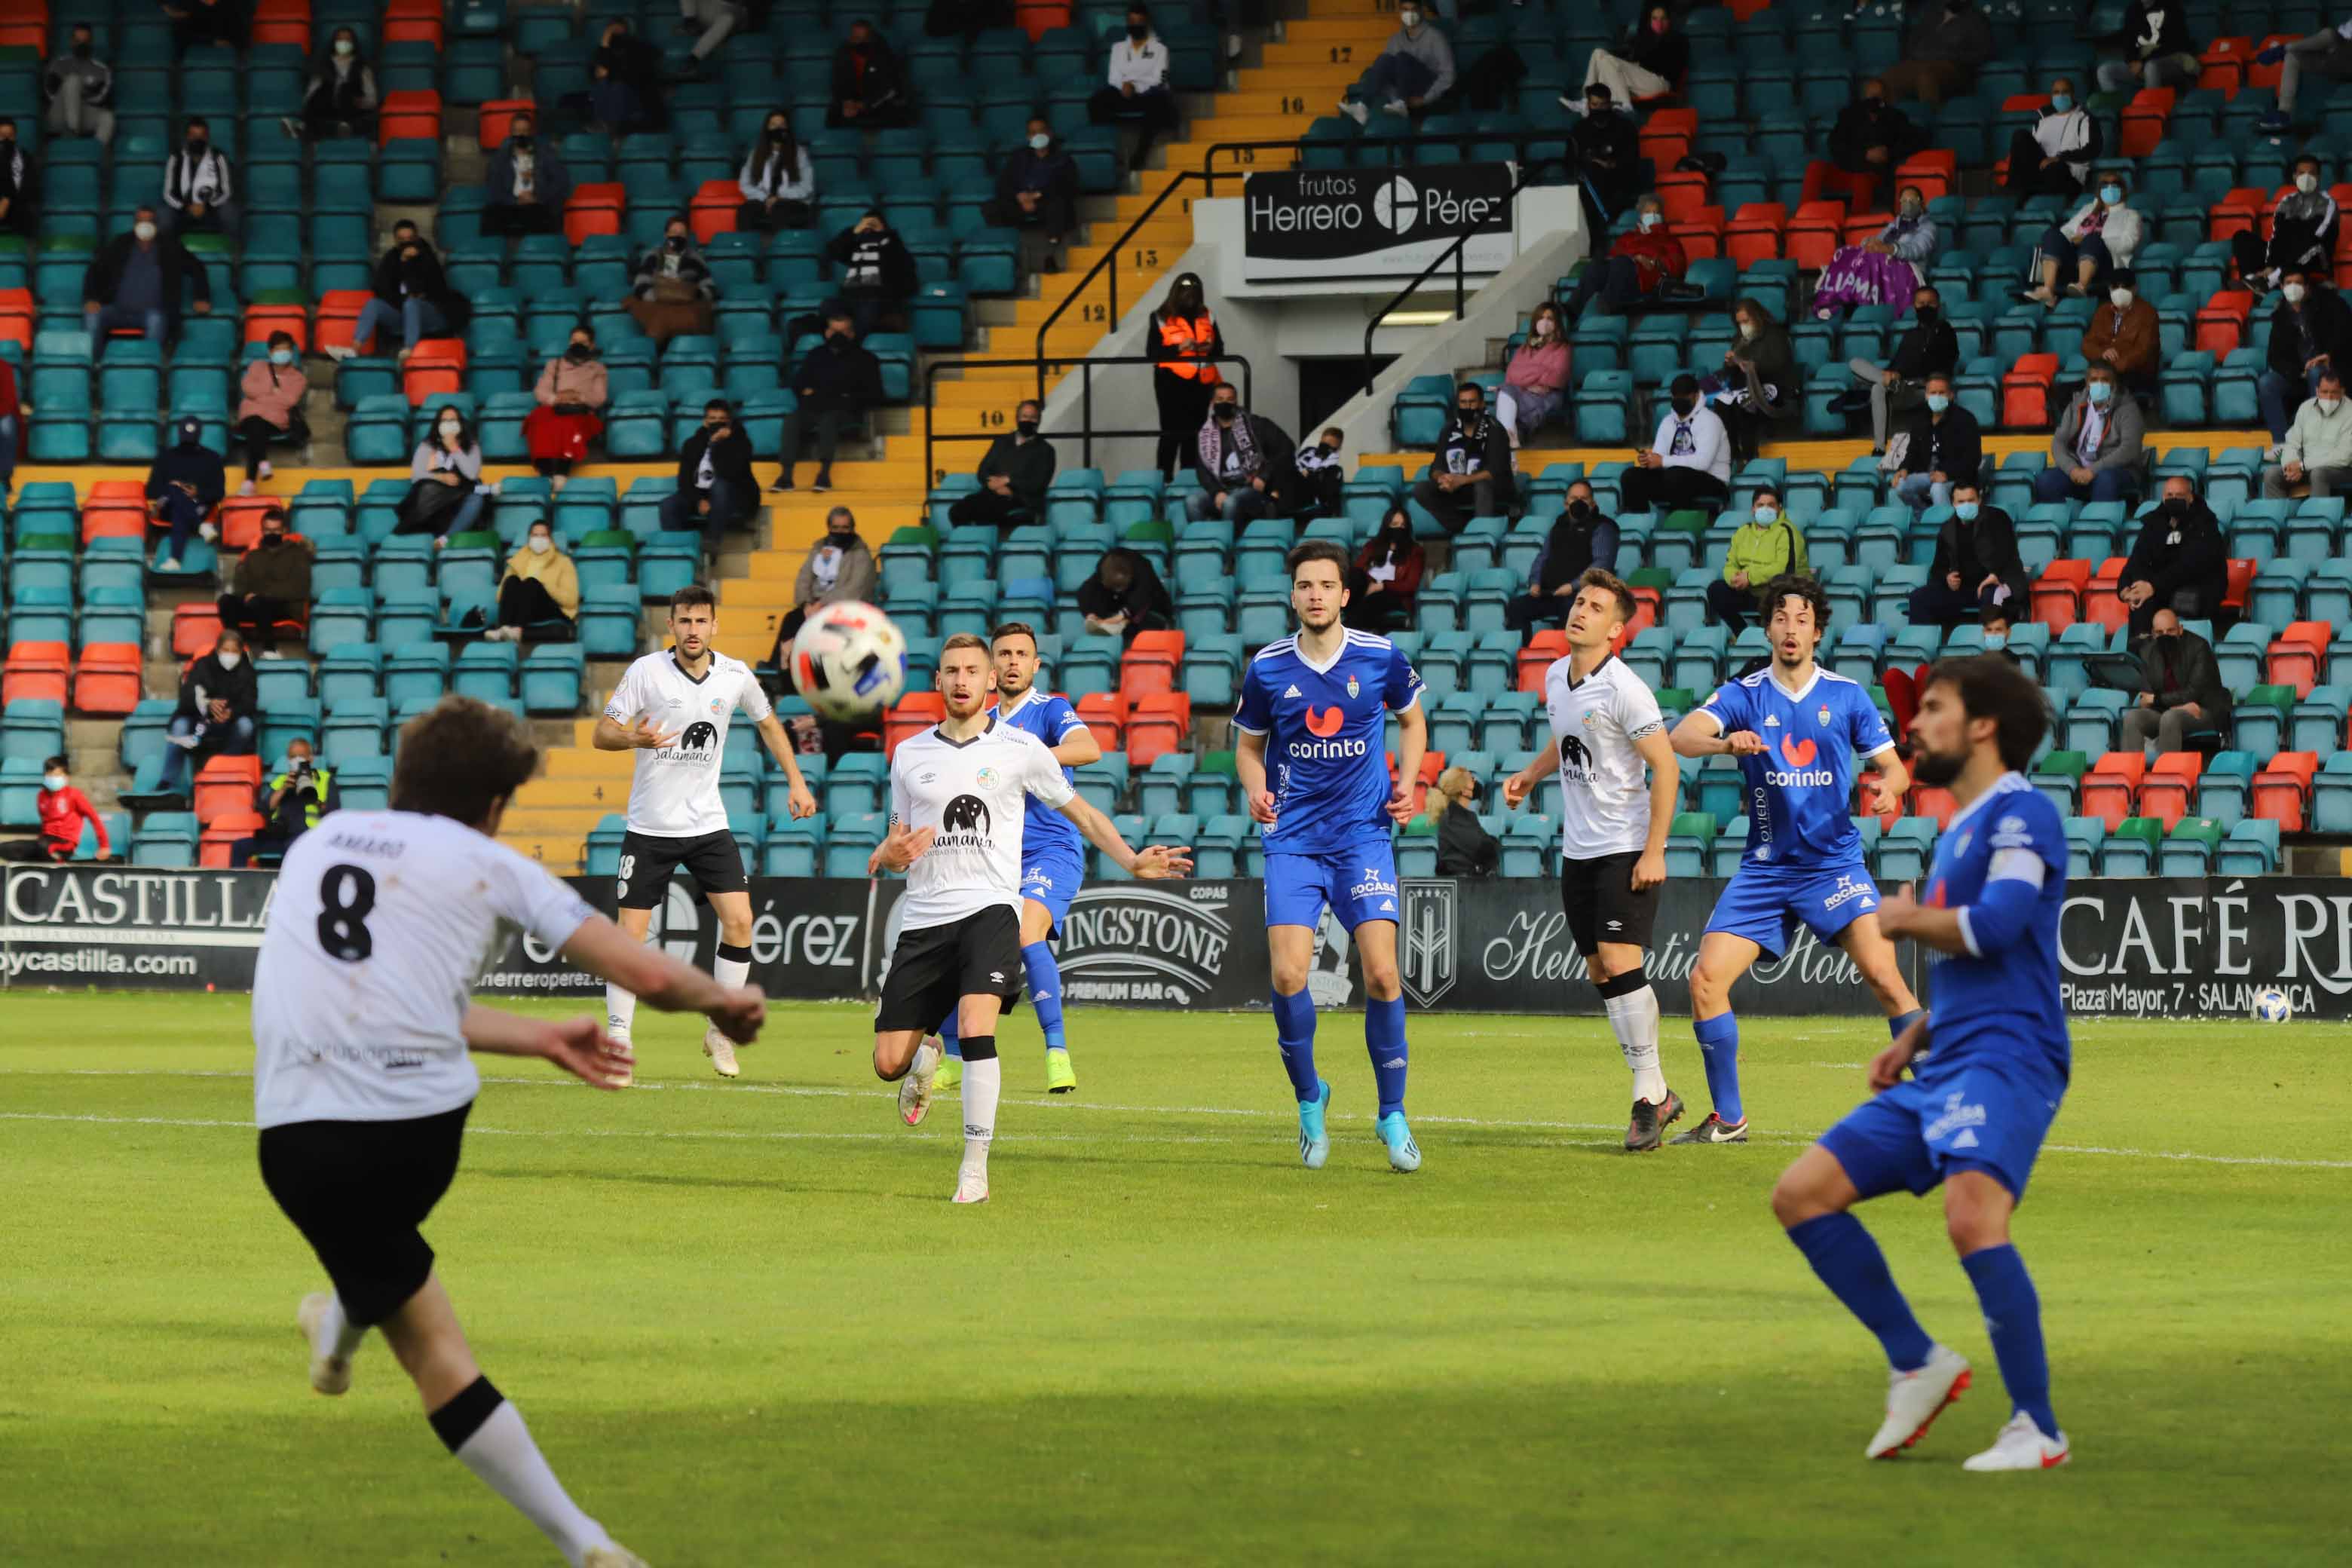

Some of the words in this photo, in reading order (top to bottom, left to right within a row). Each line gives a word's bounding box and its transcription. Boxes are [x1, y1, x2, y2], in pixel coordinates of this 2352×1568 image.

[1331, 47, 1351, 63] 17
[1282, 96, 1303, 113] 16
[1299, 173, 1357, 196] frutas
[1251, 194, 1362, 232] Herrero
[1083, 305, 1105, 322] 12
[981, 410, 1004, 427] 10
[766, 614, 776, 630] 7
[1289, 738, 1366, 759] corinto
[1765, 768, 1833, 788] corinto
[593, 786, 604, 801] 4
[618, 855, 635, 880] 18
[1190, 887, 1228, 899] COPAS
[1350, 881, 1398, 896] ROCASA
[1824, 883, 1872, 908] ROCASA
[317, 864, 376, 962] 8
[716, 899, 859, 966] érez
[2057, 880, 2251, 975] CAFÉ
[1050, 906, 1228, 975] INGSTONE
[1067, 982, 1129, 1000] PREMIUM
[1132, 982, 1163, 1000] BAR
[2060, 983, 2105, 1011] Plaza
[2111, 982, 2168, 1016] Mayor,
[2172, 983, 2185, 1011] 7
